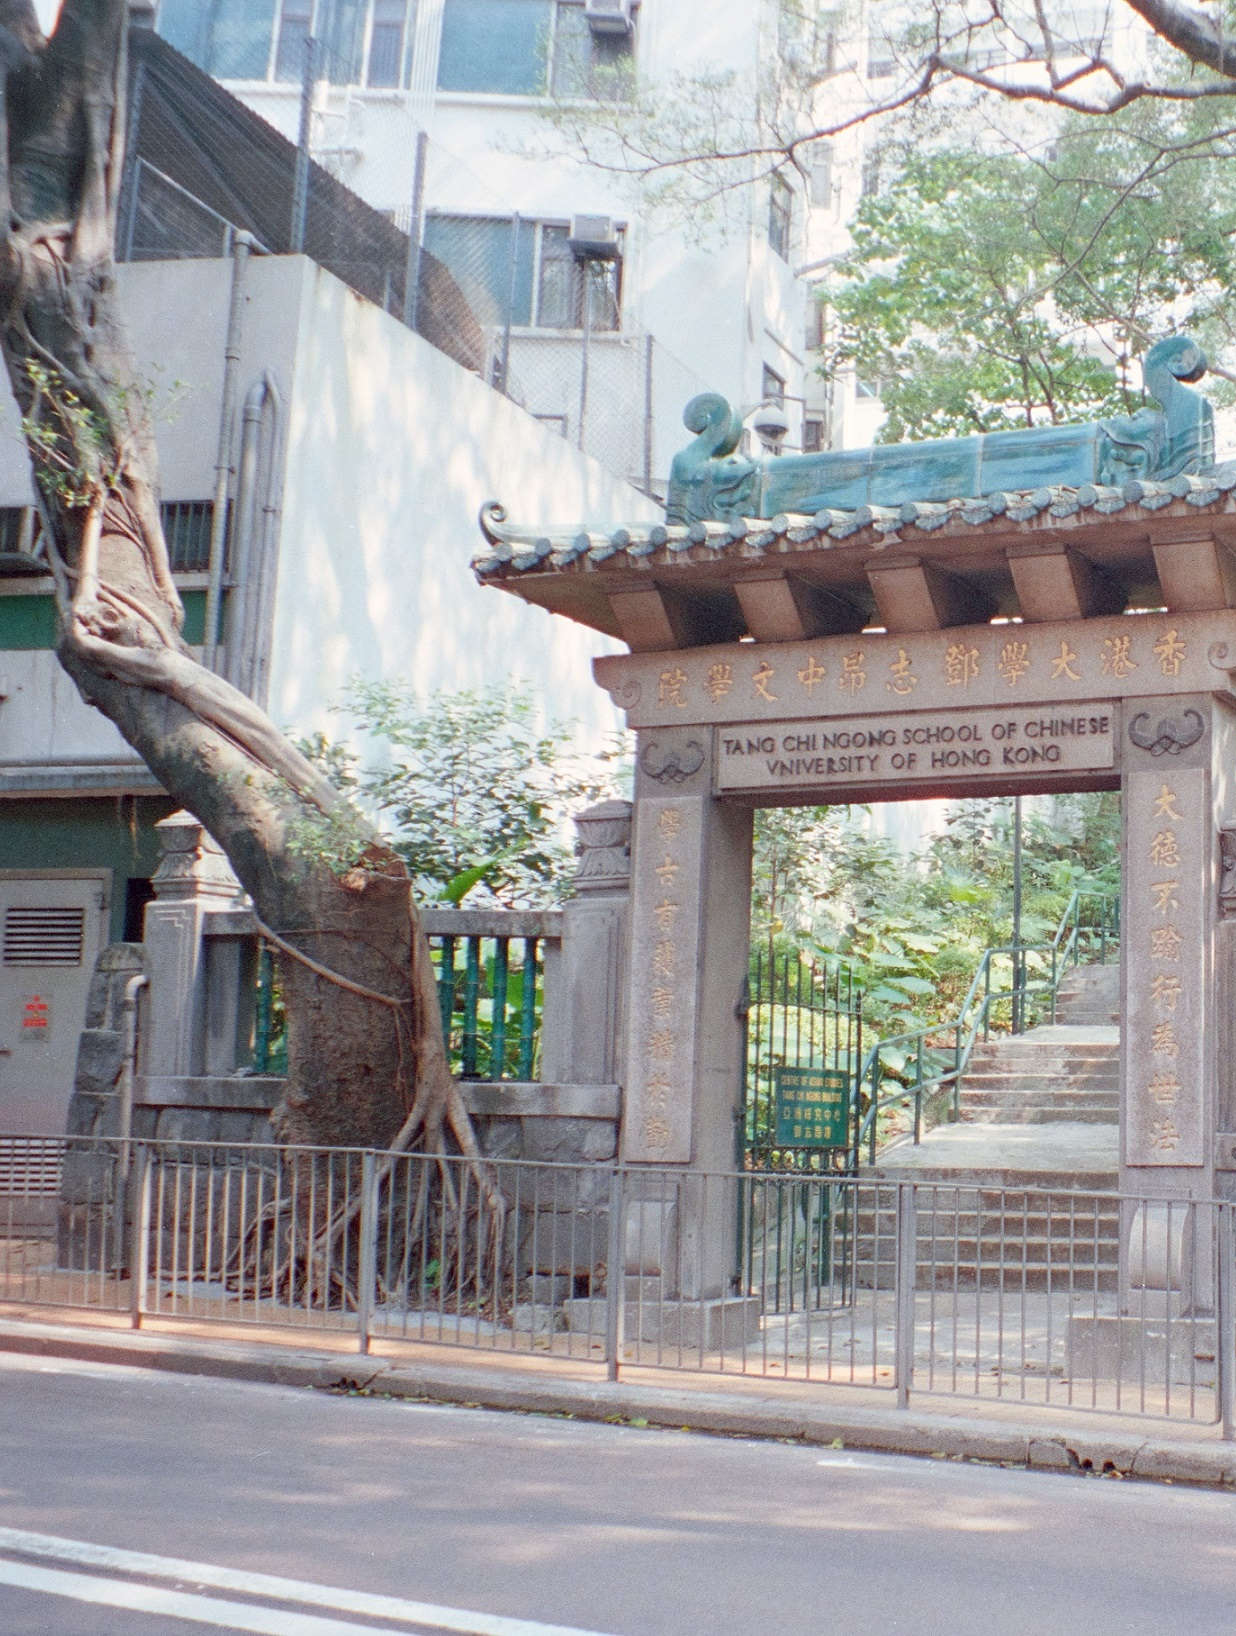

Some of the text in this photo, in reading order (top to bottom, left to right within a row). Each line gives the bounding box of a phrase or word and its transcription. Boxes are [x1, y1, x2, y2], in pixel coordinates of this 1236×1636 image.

[723, 716, 1110, 756] TANG CHI NGONG SCHOOL OF CHINESE
[891, 752, 917, 770] OF
[931, 749, 991, 769] HONG
[1003, 744, 1061, 765] KONG
